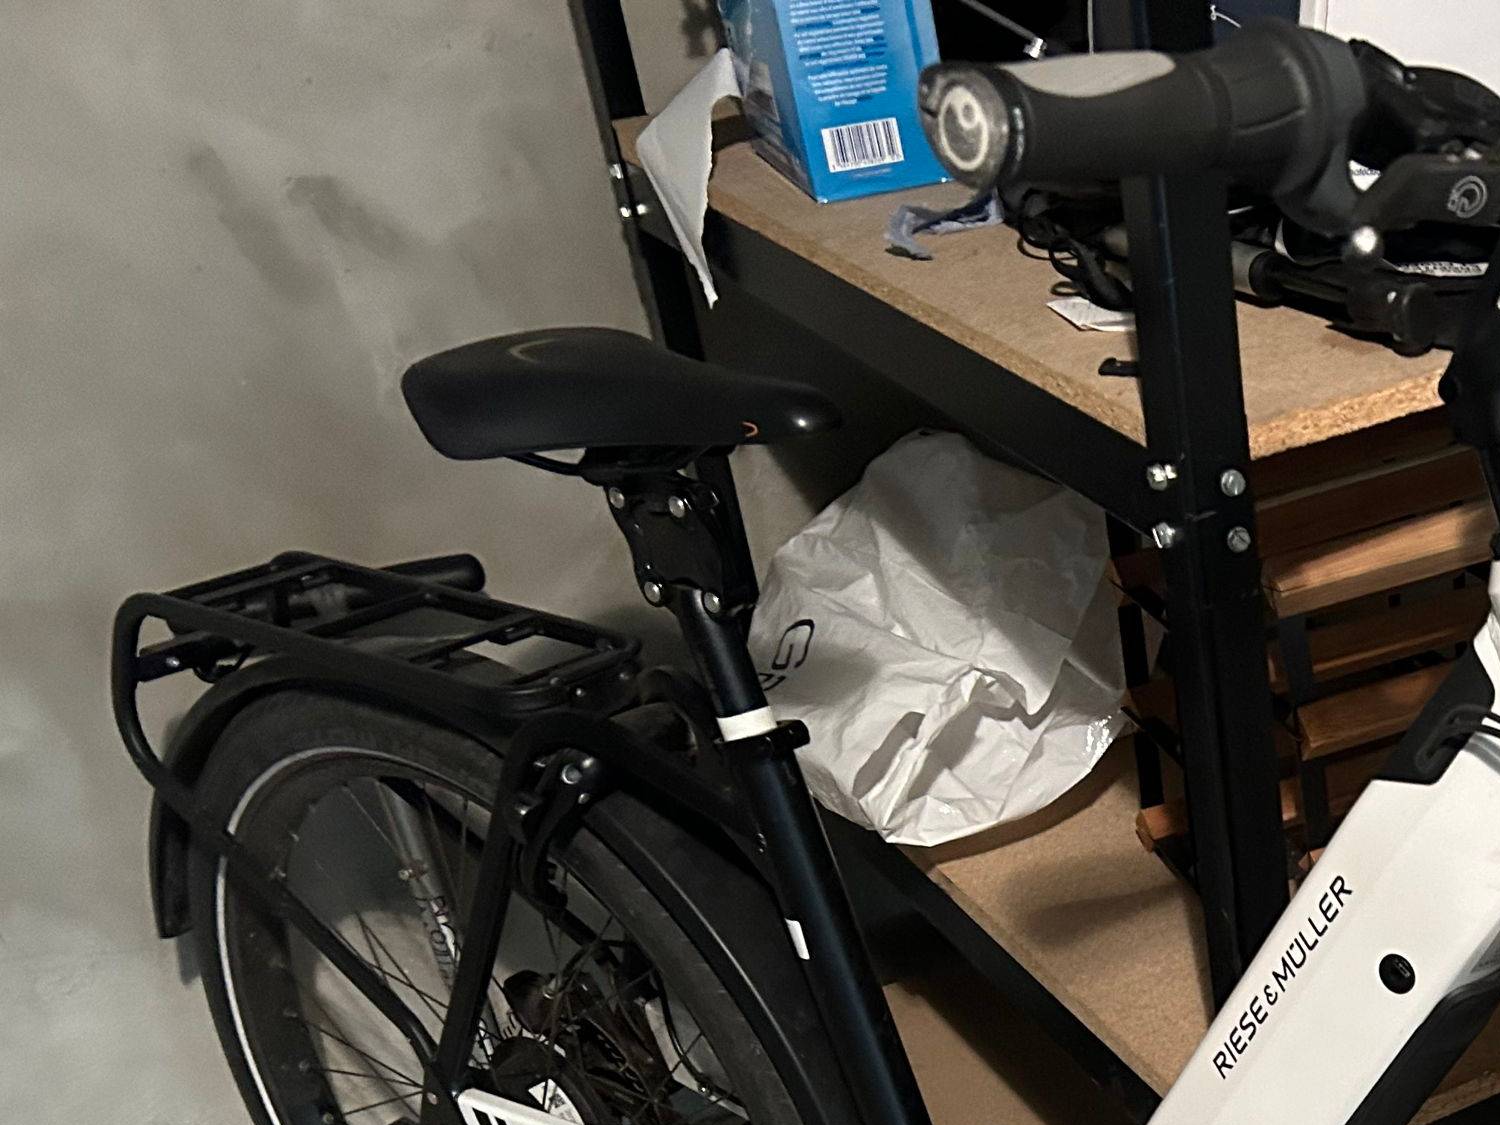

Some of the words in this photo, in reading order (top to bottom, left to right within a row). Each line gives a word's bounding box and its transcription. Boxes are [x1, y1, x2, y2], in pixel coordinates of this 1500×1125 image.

[1212, 996, 1269, 1080] RIESE
[1263, 984, 1279, 1006] &
[1271, 875, 1353, 993] MÜLLER
